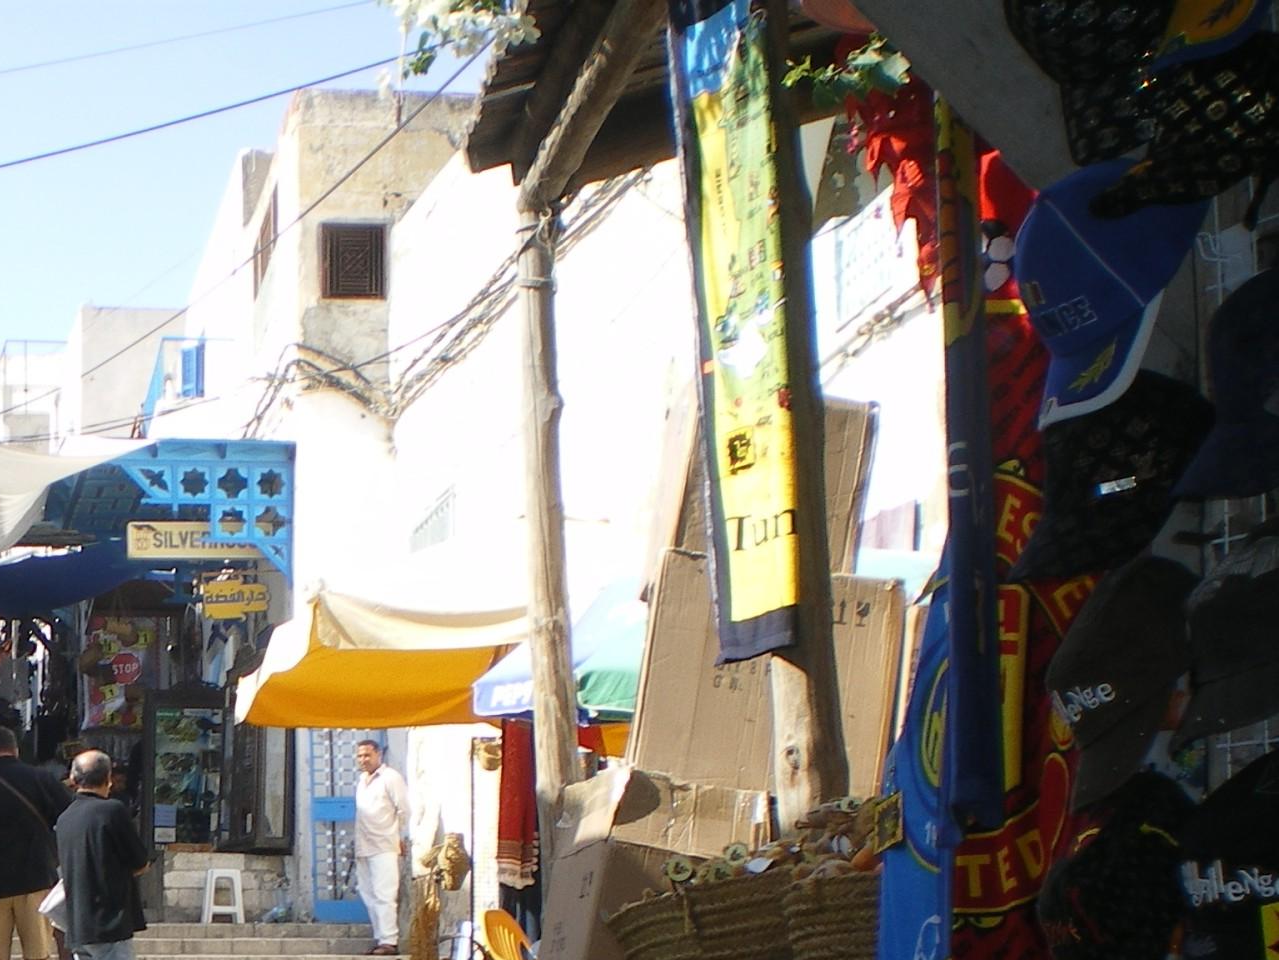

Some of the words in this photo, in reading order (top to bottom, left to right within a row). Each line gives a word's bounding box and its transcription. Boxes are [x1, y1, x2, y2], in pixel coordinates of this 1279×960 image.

[153, 530, 257, 549] SILVER
[725, 508, 799, 552] Tun
[112, 662, 139, 675] STOP
